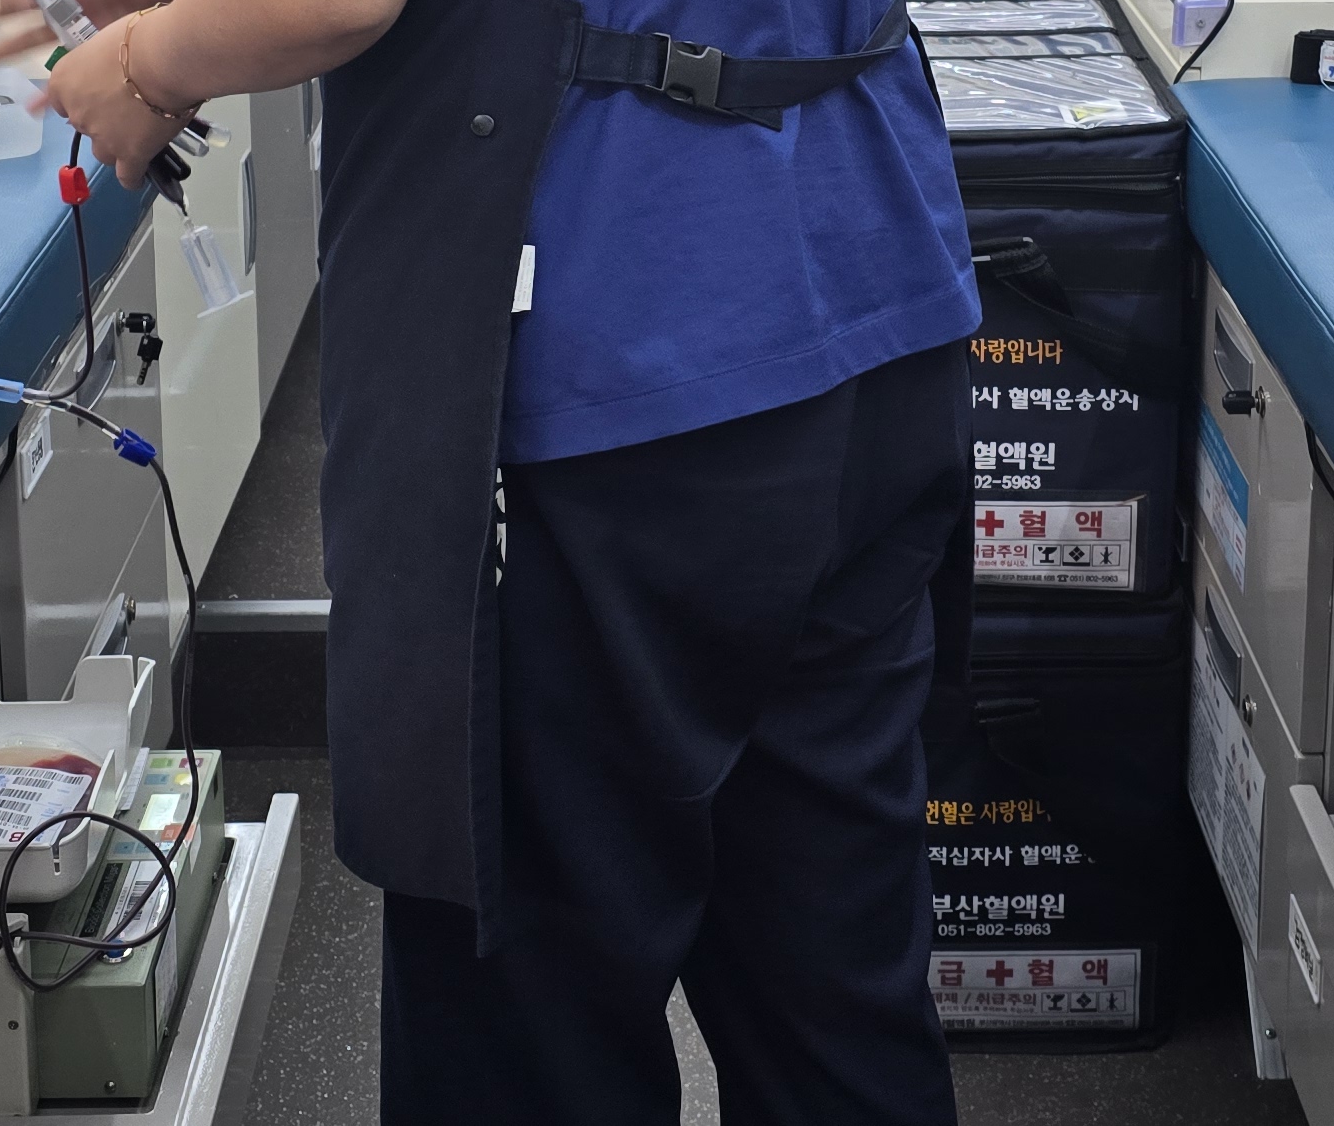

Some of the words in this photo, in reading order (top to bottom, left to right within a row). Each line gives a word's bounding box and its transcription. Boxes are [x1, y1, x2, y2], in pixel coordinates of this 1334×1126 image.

[970, 338, 1063, 365] 사랑입니다
[973, 440, 1056, 471] 혈액원
[8, 831, 26, 843] B
[928, 845, 1013, 867] 적십자사
[1020, 844, 1097, 866] 혈액운
[932, 893, 1066, 921] 부산혈액원
[937, 923, 1052, 937] 051-802-5963
[976, 992, 1037, 1007] 취급주의
